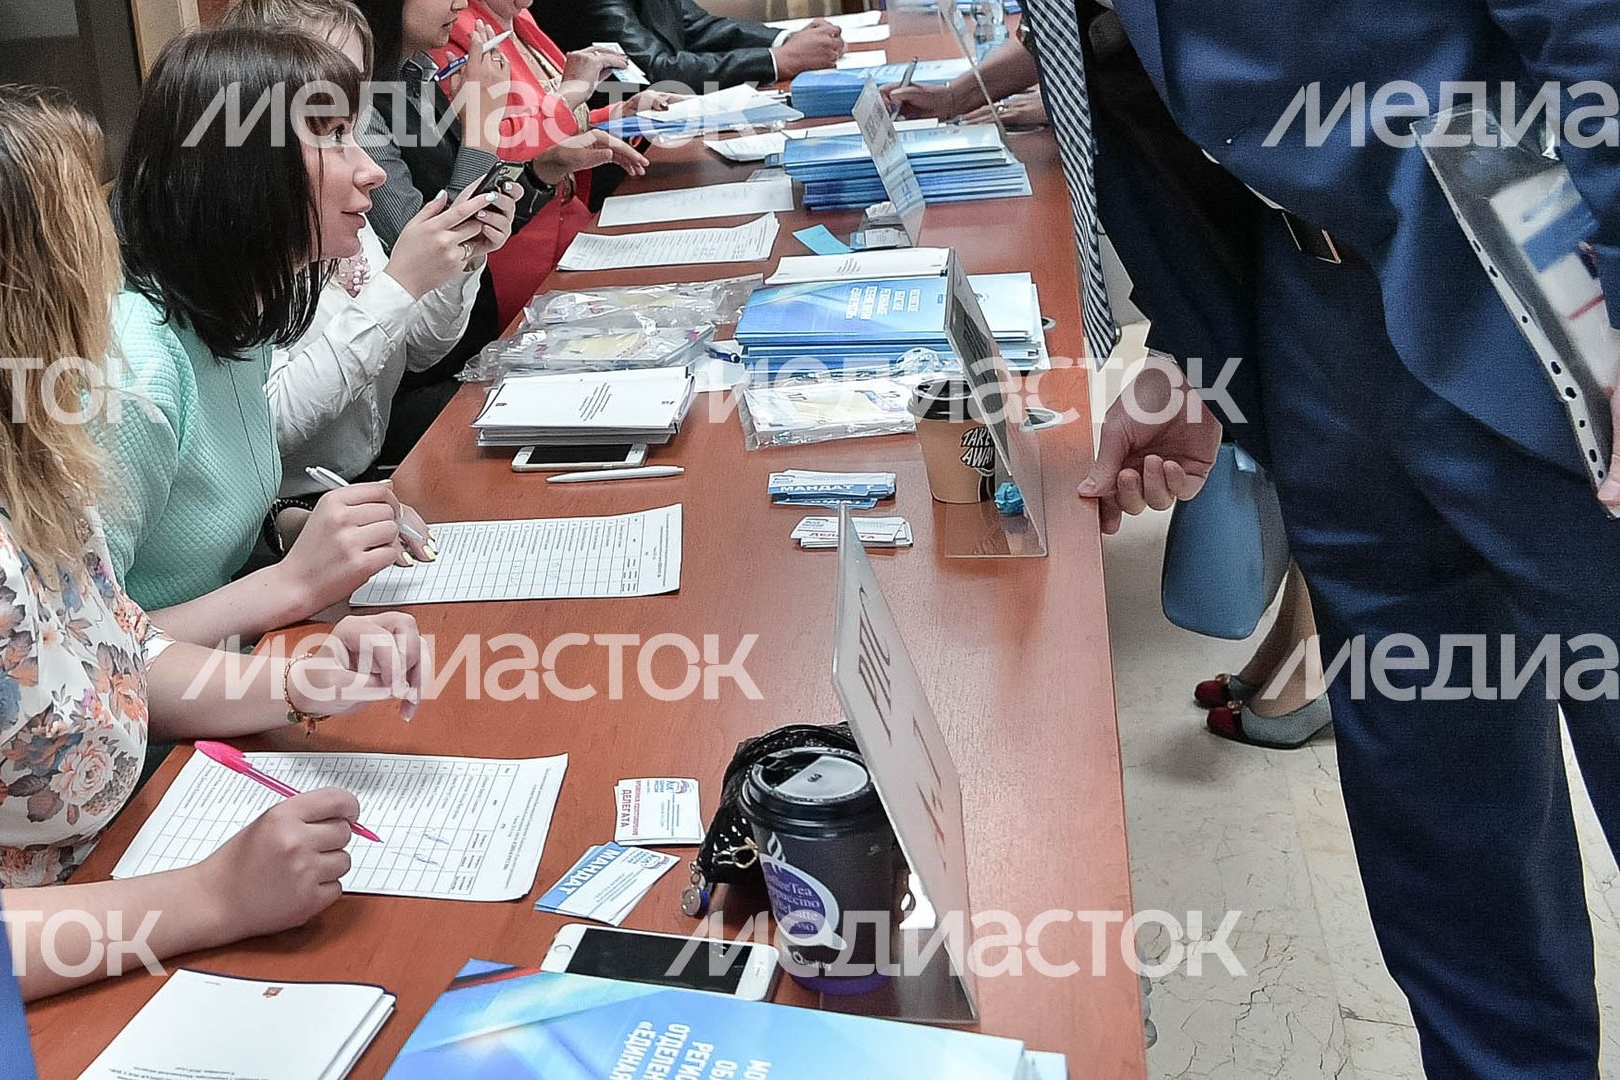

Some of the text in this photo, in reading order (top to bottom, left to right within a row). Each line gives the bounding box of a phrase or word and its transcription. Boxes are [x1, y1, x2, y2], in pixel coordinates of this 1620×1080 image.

[780, 484, 855, 492] МАНДАТ
[620, 788, 633, 828] ДЕЛЕГАТА
[558, 849, 621, 896] МАНДАТ
